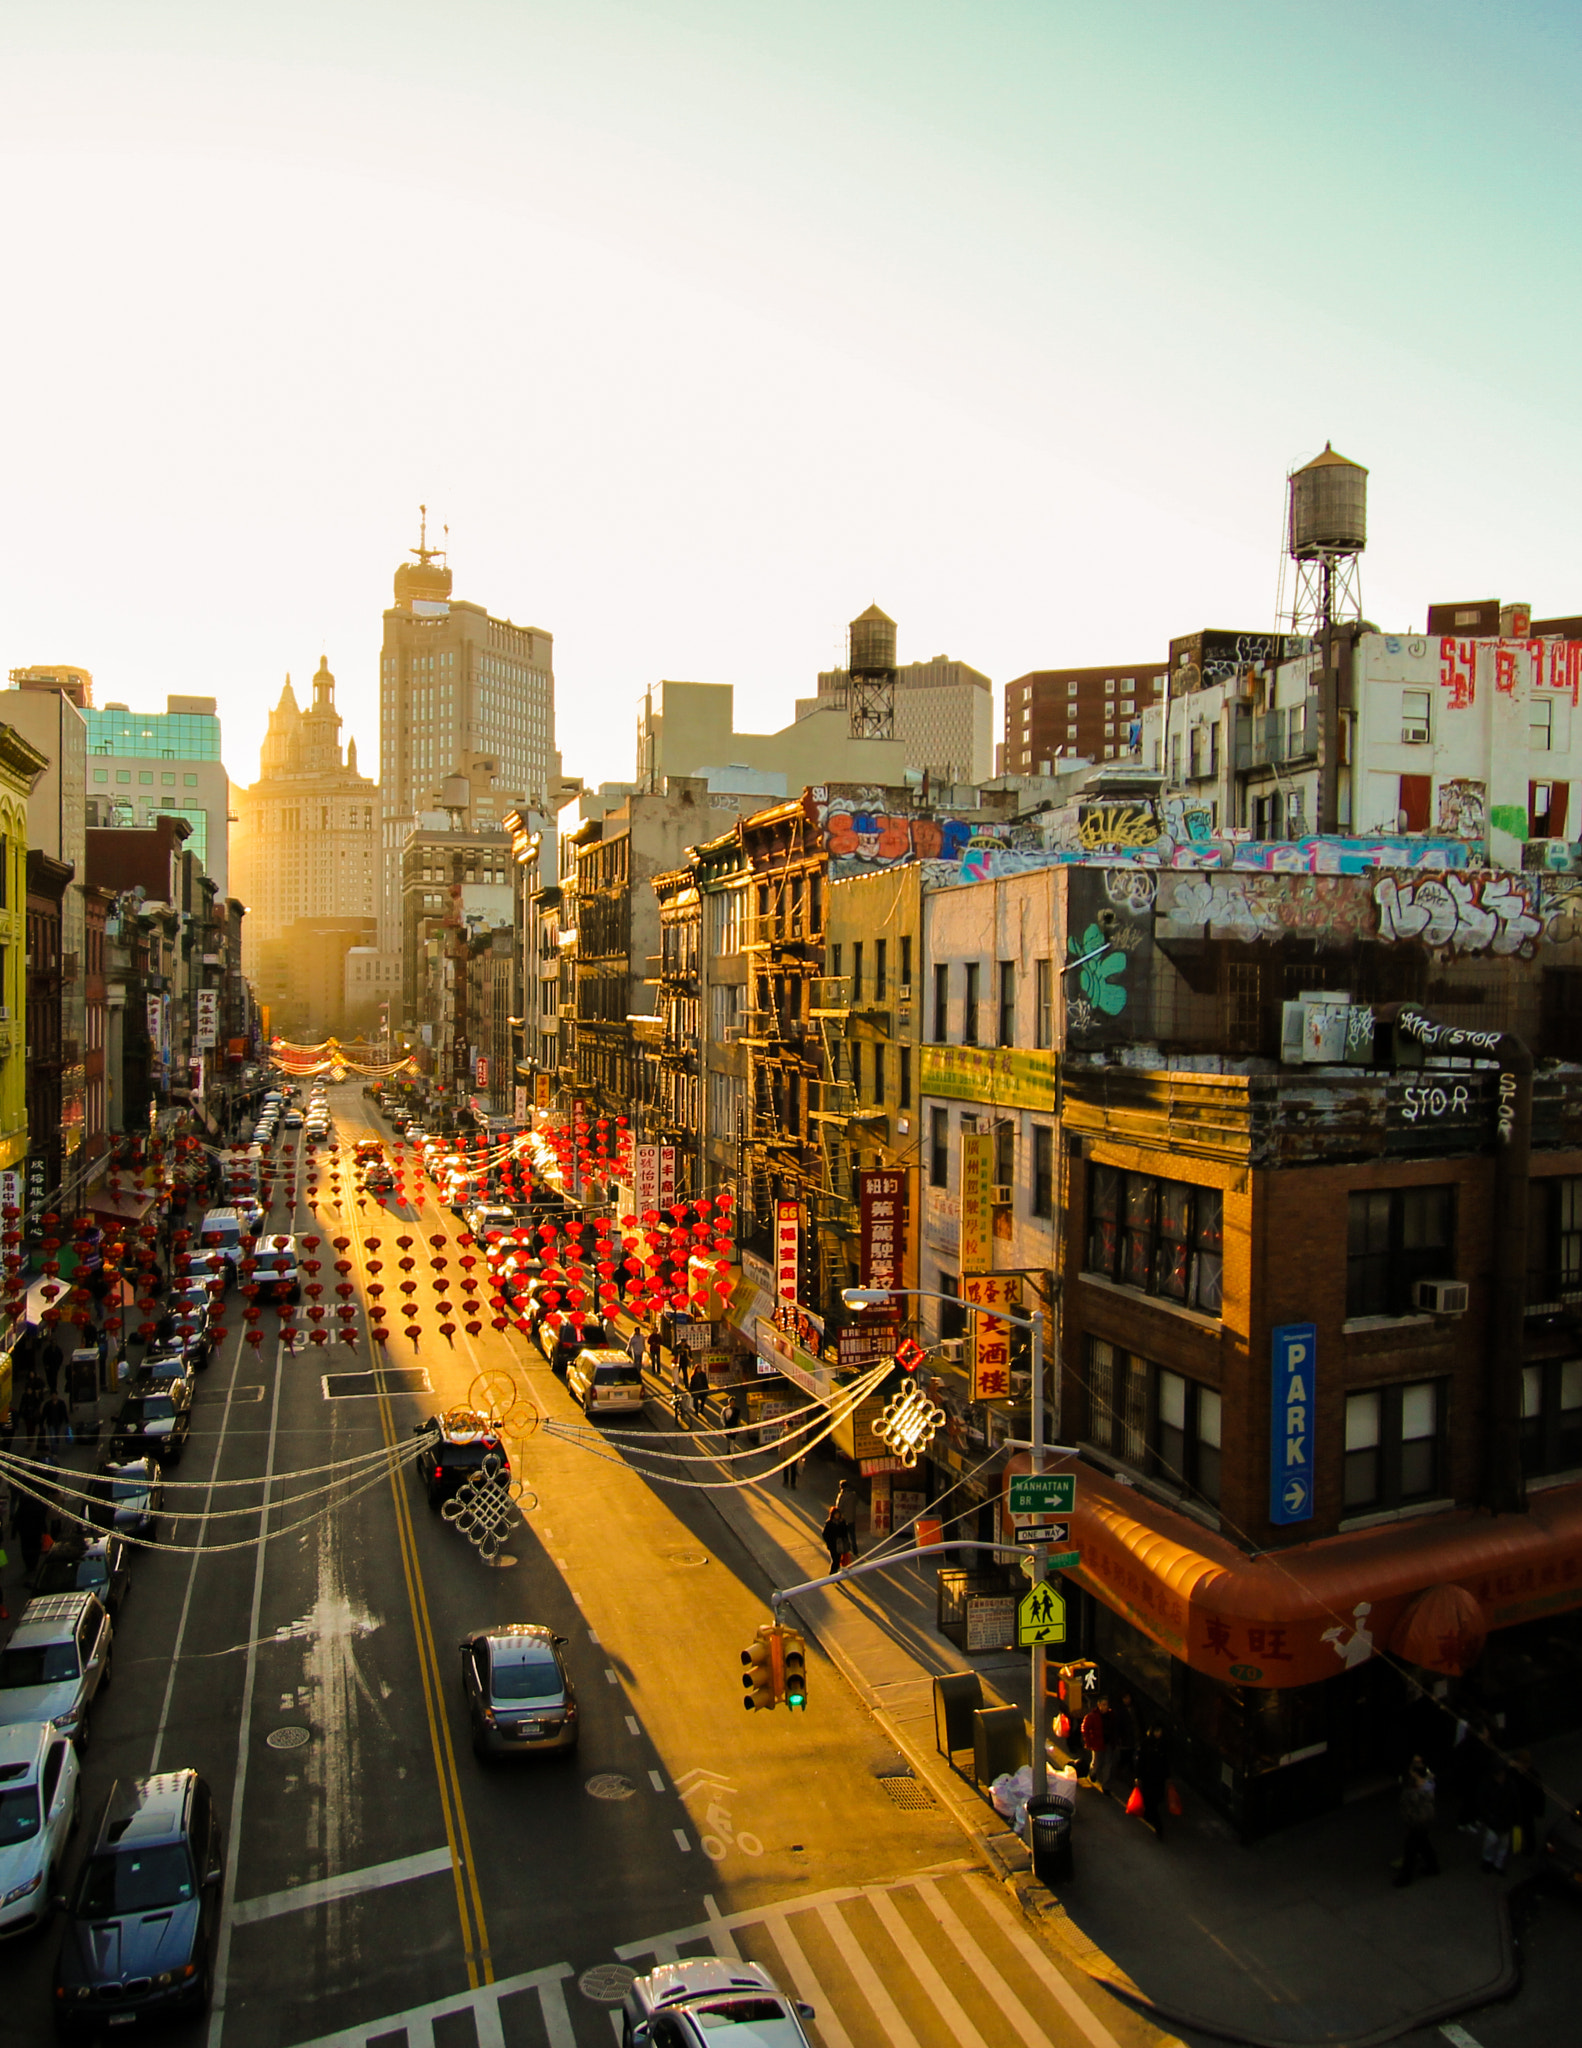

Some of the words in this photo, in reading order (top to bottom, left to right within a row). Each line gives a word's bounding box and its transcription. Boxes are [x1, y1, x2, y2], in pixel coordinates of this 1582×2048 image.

[1401, 1085, 1469, 1123] STOR
[780, 1207, 798, 1219] 66
[1286, 1343, 1307, 1466] PARK
[1016, 1481, 1069, 1492] MANHATTAN
[1022, 1531, 1038, 1539] ONE
[1044, 1529, 1061, 1537] WAY
[1202, 1615, 1294, 1662] 東旺
